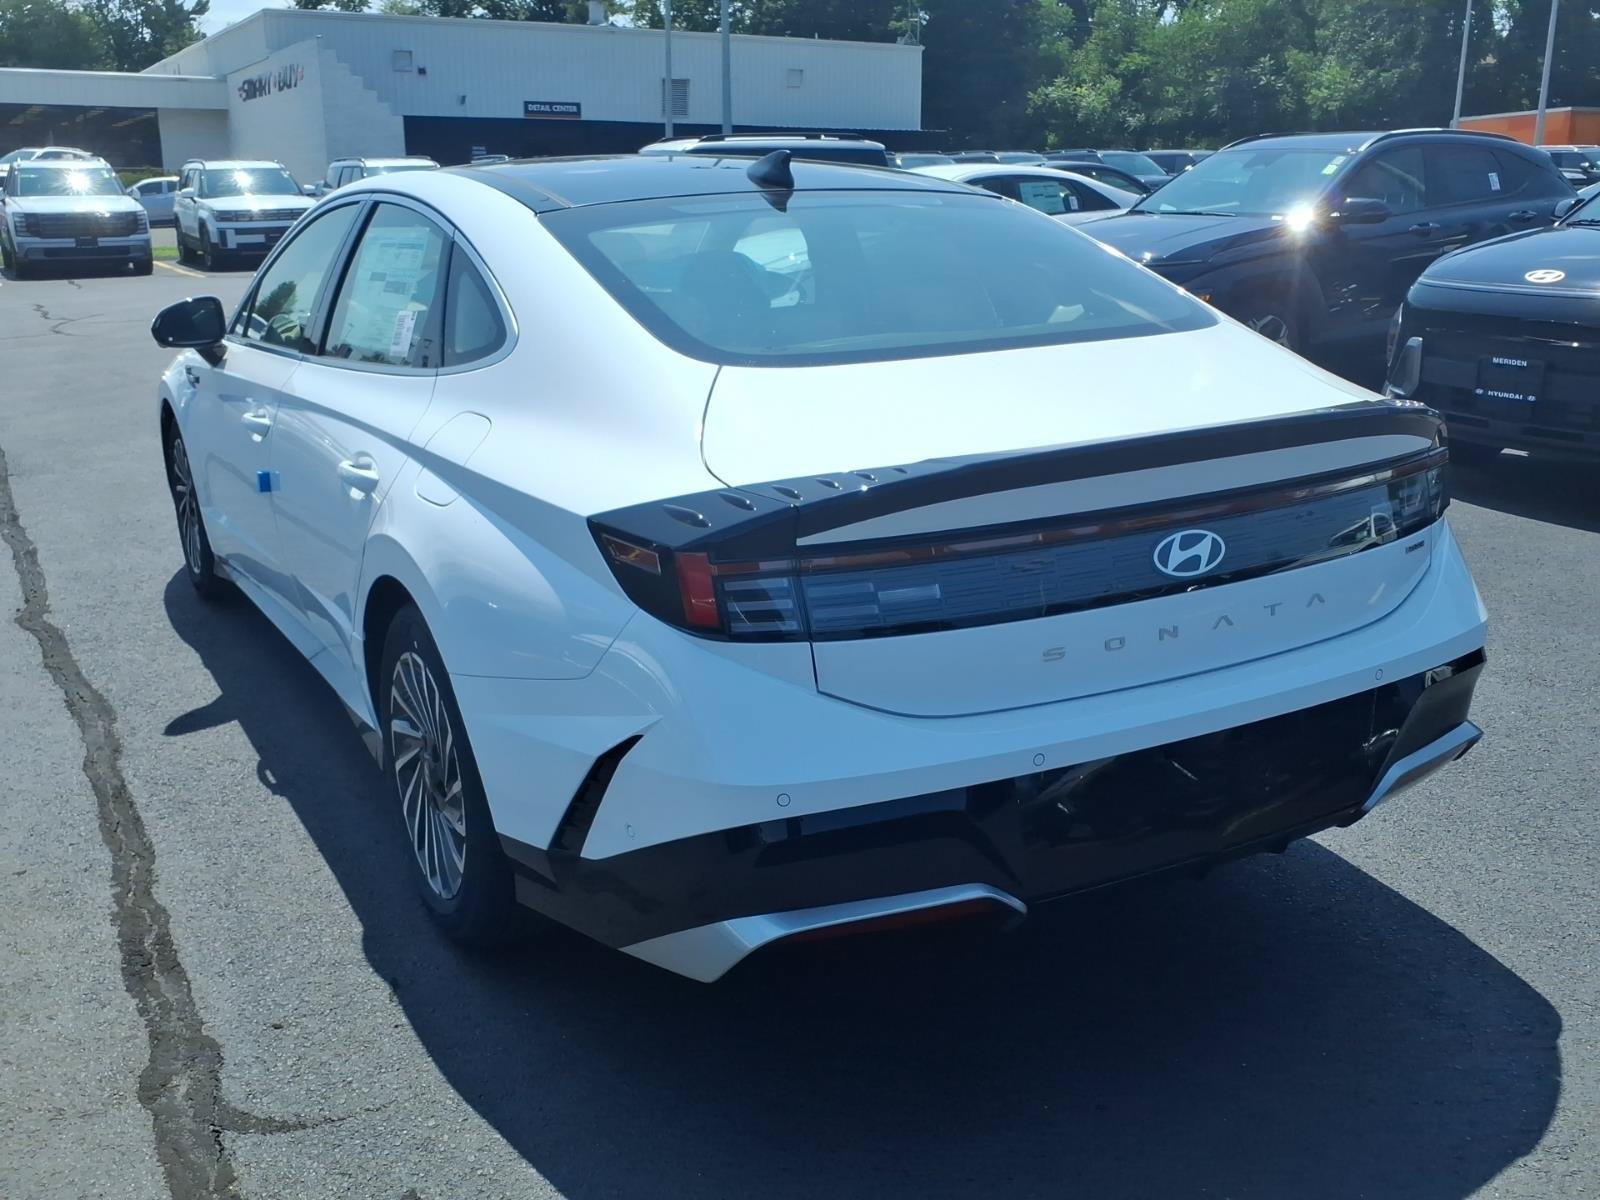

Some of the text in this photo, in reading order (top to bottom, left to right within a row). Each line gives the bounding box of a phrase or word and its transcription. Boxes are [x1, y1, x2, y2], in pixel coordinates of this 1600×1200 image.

[242, 64, 300, 102] SMART BUY
[1492, 357, 1527, 367] MERIDEN
[1487, 389, 1523, 400] HYUNDAI
[1042, 593, 1325, 662] SONATA
